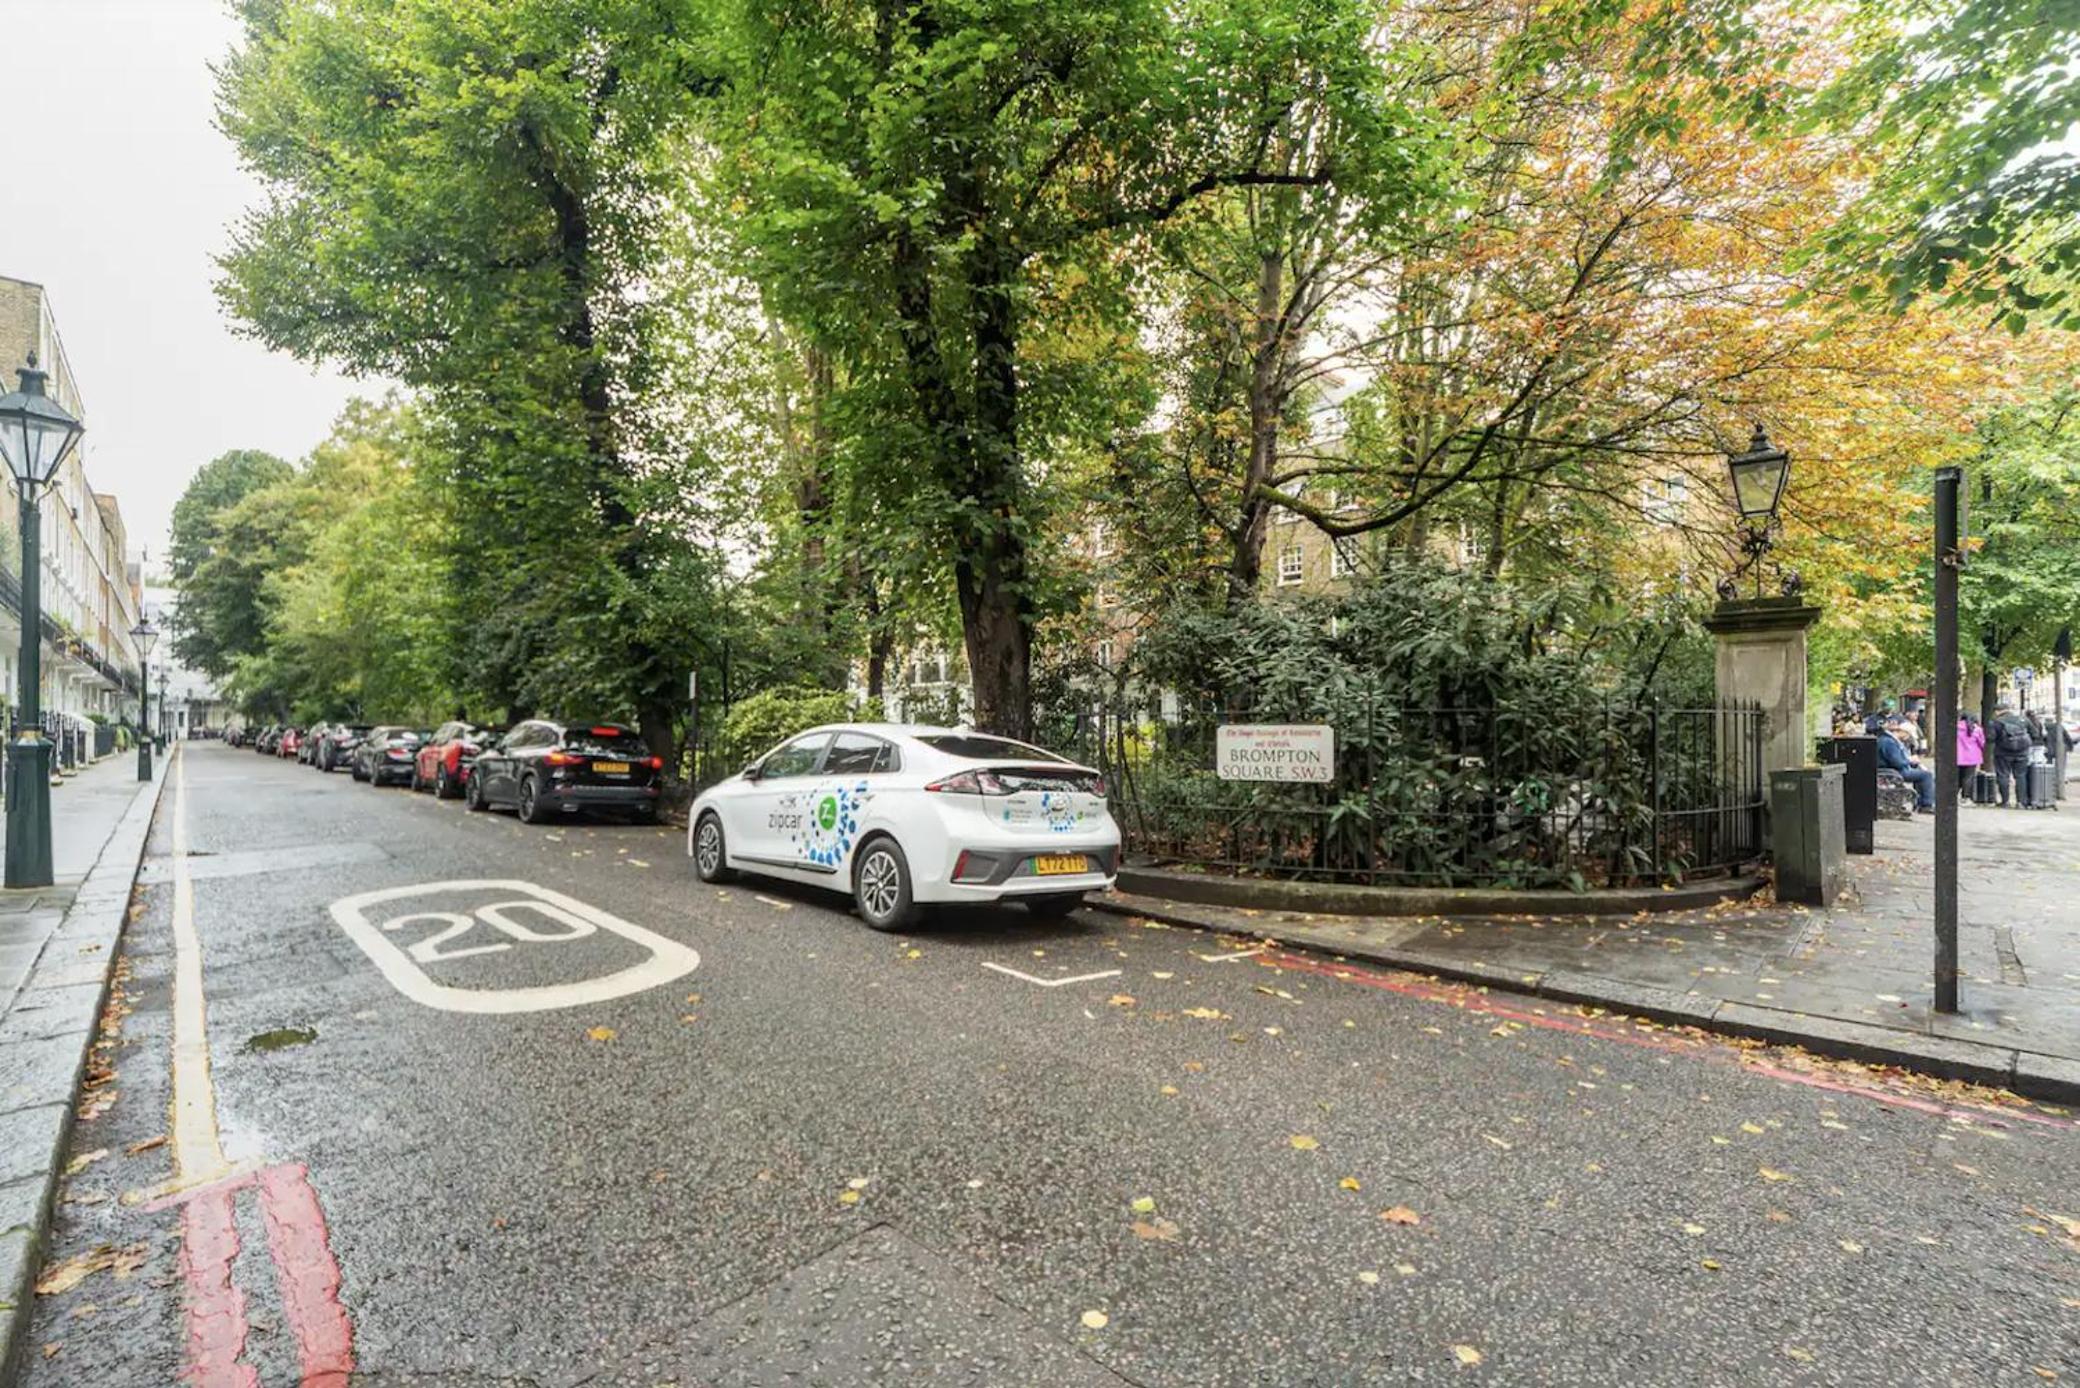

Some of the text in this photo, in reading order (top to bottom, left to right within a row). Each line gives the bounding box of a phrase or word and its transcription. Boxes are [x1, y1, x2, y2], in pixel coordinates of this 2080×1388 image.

[1230, 749, 1321, 763] BROMPTON
[768, 812, 803, 833] zipcar
[384, 901, 598, 963] 20
